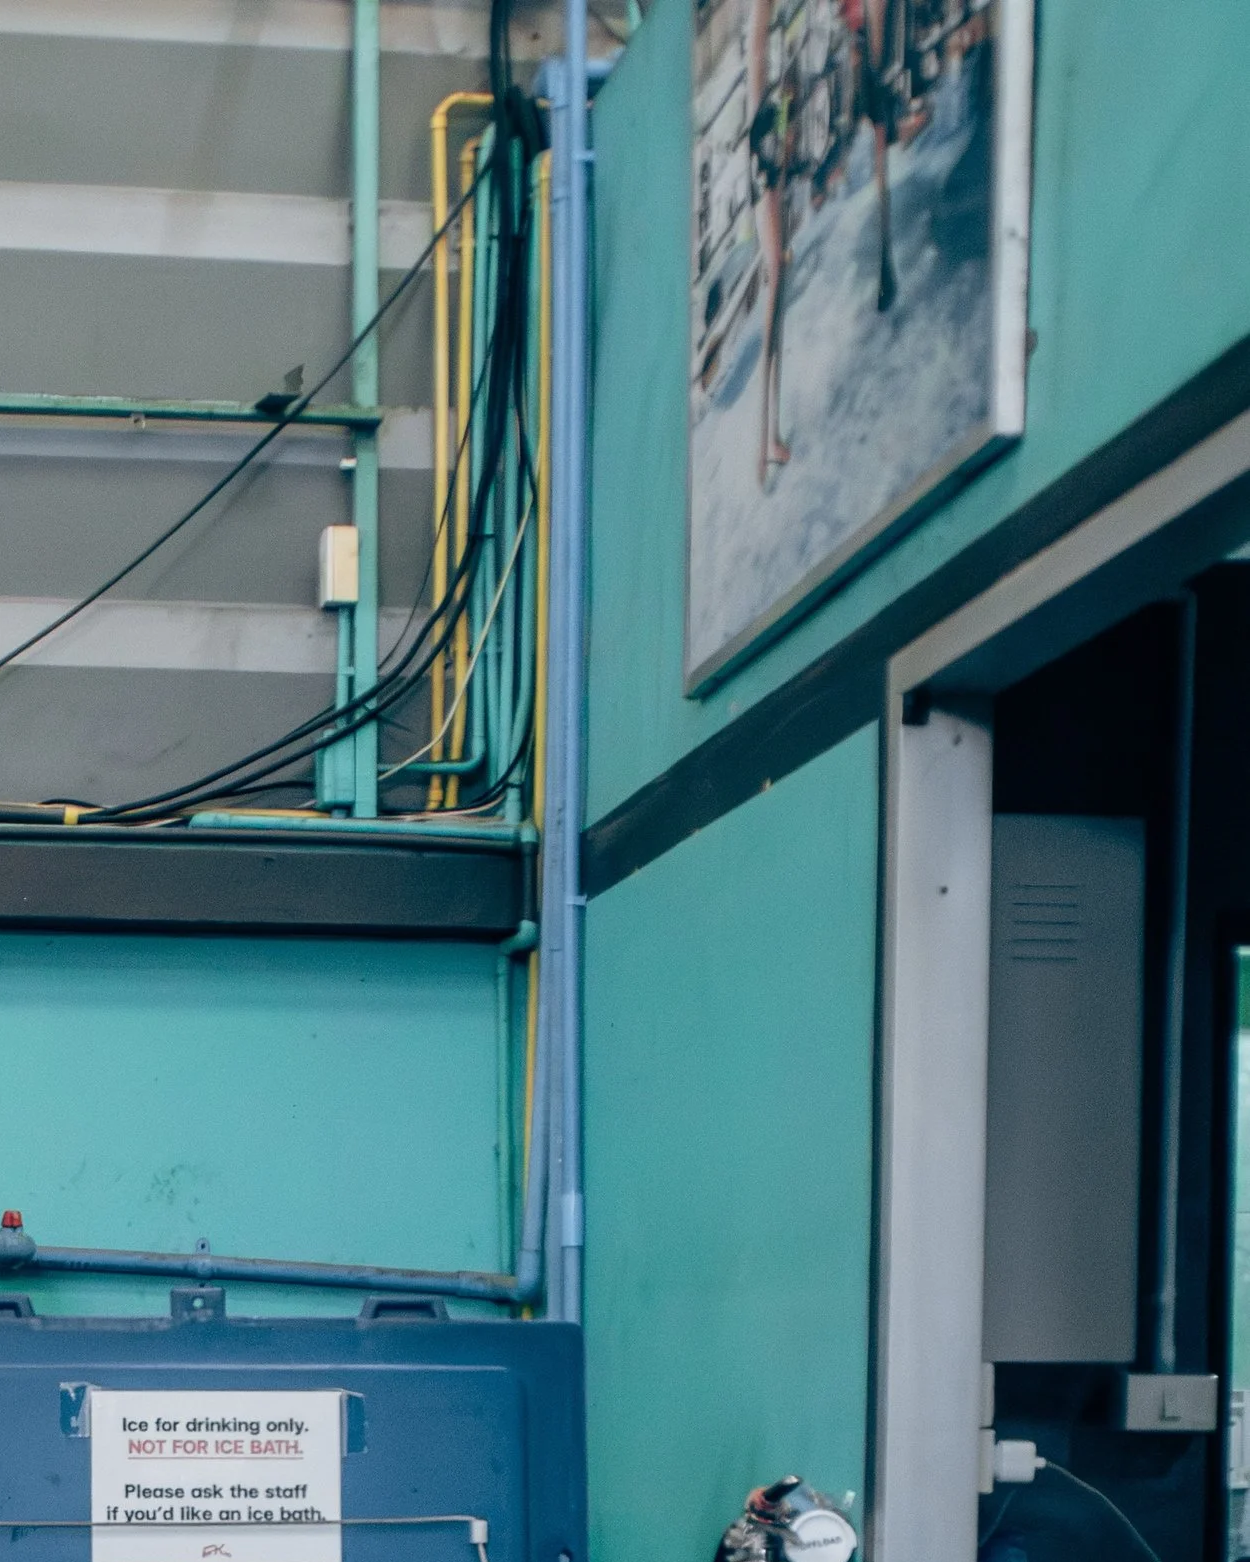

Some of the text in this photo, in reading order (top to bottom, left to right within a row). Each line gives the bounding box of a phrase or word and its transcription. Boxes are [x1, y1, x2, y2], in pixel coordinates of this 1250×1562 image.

[122, 1417, 309, 1436] Ice for drinking only.
[128, 1439, 303, 1455] NOT FOR ICE BATH.
[124, 1483, 308, 1499] Please ask the staff
[106, 1506, 326, 1523] if you'd like an ice bath.
